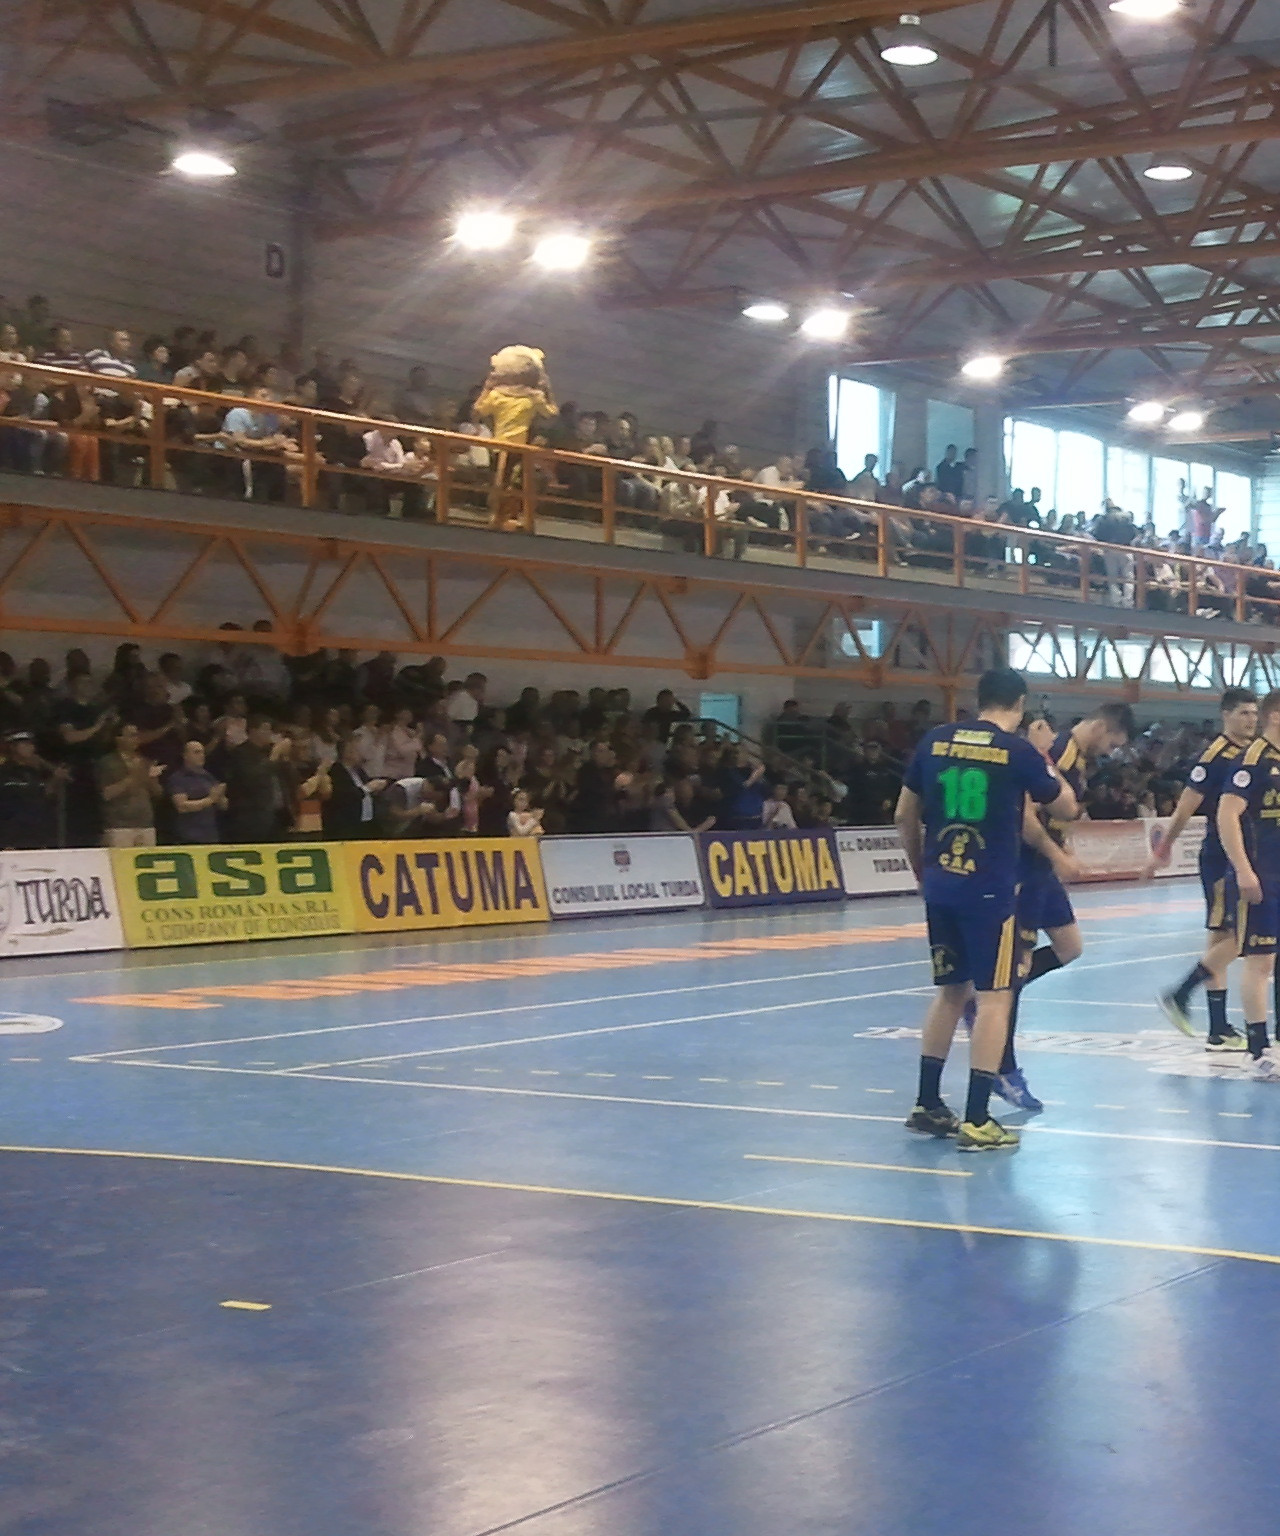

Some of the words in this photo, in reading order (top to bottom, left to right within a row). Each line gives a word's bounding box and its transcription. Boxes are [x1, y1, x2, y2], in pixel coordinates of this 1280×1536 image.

[938, 766, 988, 822] 18
[134, 848, 333, 901] asa
[361, 849, 540, 920] CATUMA
[552, 884, 618, 904] CONSILIUL
[621, 882, 659, 900] LOCAL
[661, 880, 699, 898] TURDA
[708, 837, 840, 898] CATUMA
[15, 876, 111, 924] TURDA
[141, 907, 194, 923] CONS
[161, 920, 237, 940] COMPANY
[243, 918, 260, 935] OF
